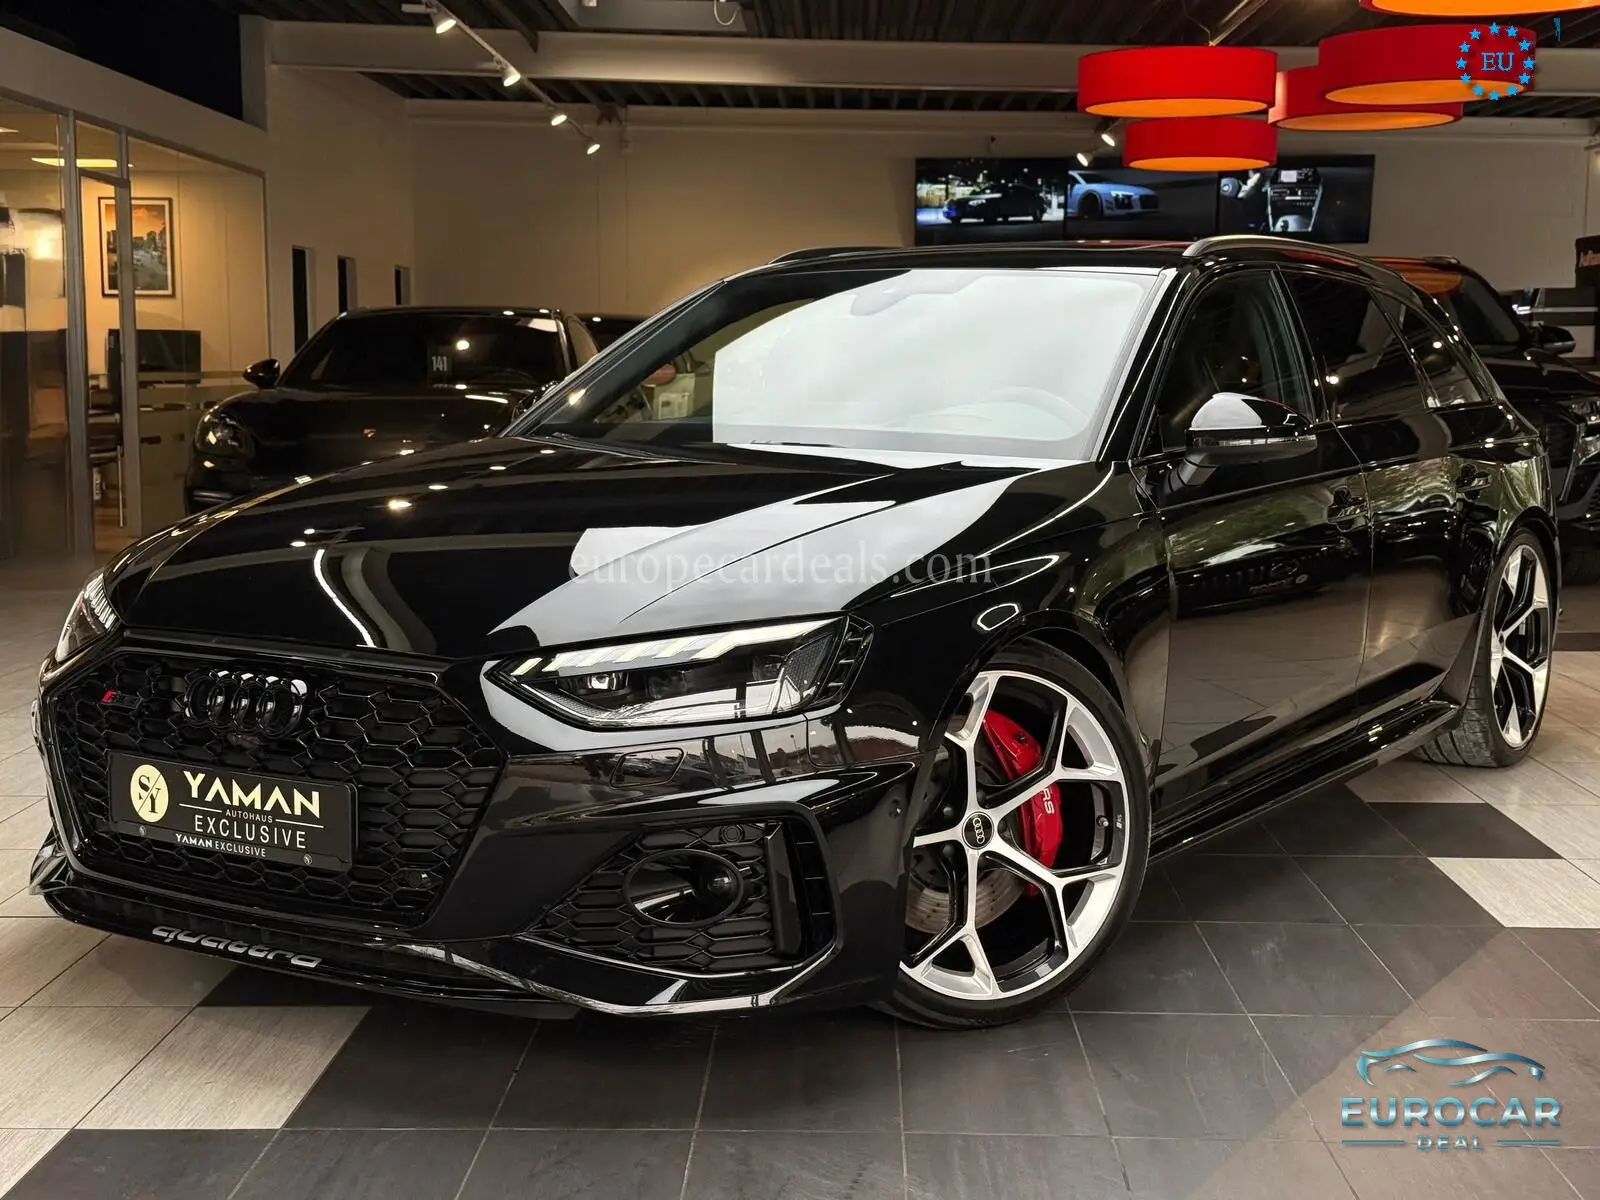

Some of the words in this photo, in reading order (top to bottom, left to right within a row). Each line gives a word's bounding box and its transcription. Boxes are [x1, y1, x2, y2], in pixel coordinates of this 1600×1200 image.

[431, 355, 448, 371] 141
[183, 770, 320, 818] YAMAN
[225, 809, 273, 824] AUTOHAUS
[175, 833, 213, 848] YAMAN
[214, 841, 266, 857] EXCLUSIVE
[194, 814, 306, 849] EXCLUSIVE
[152, 925, 322, 967] quattro
